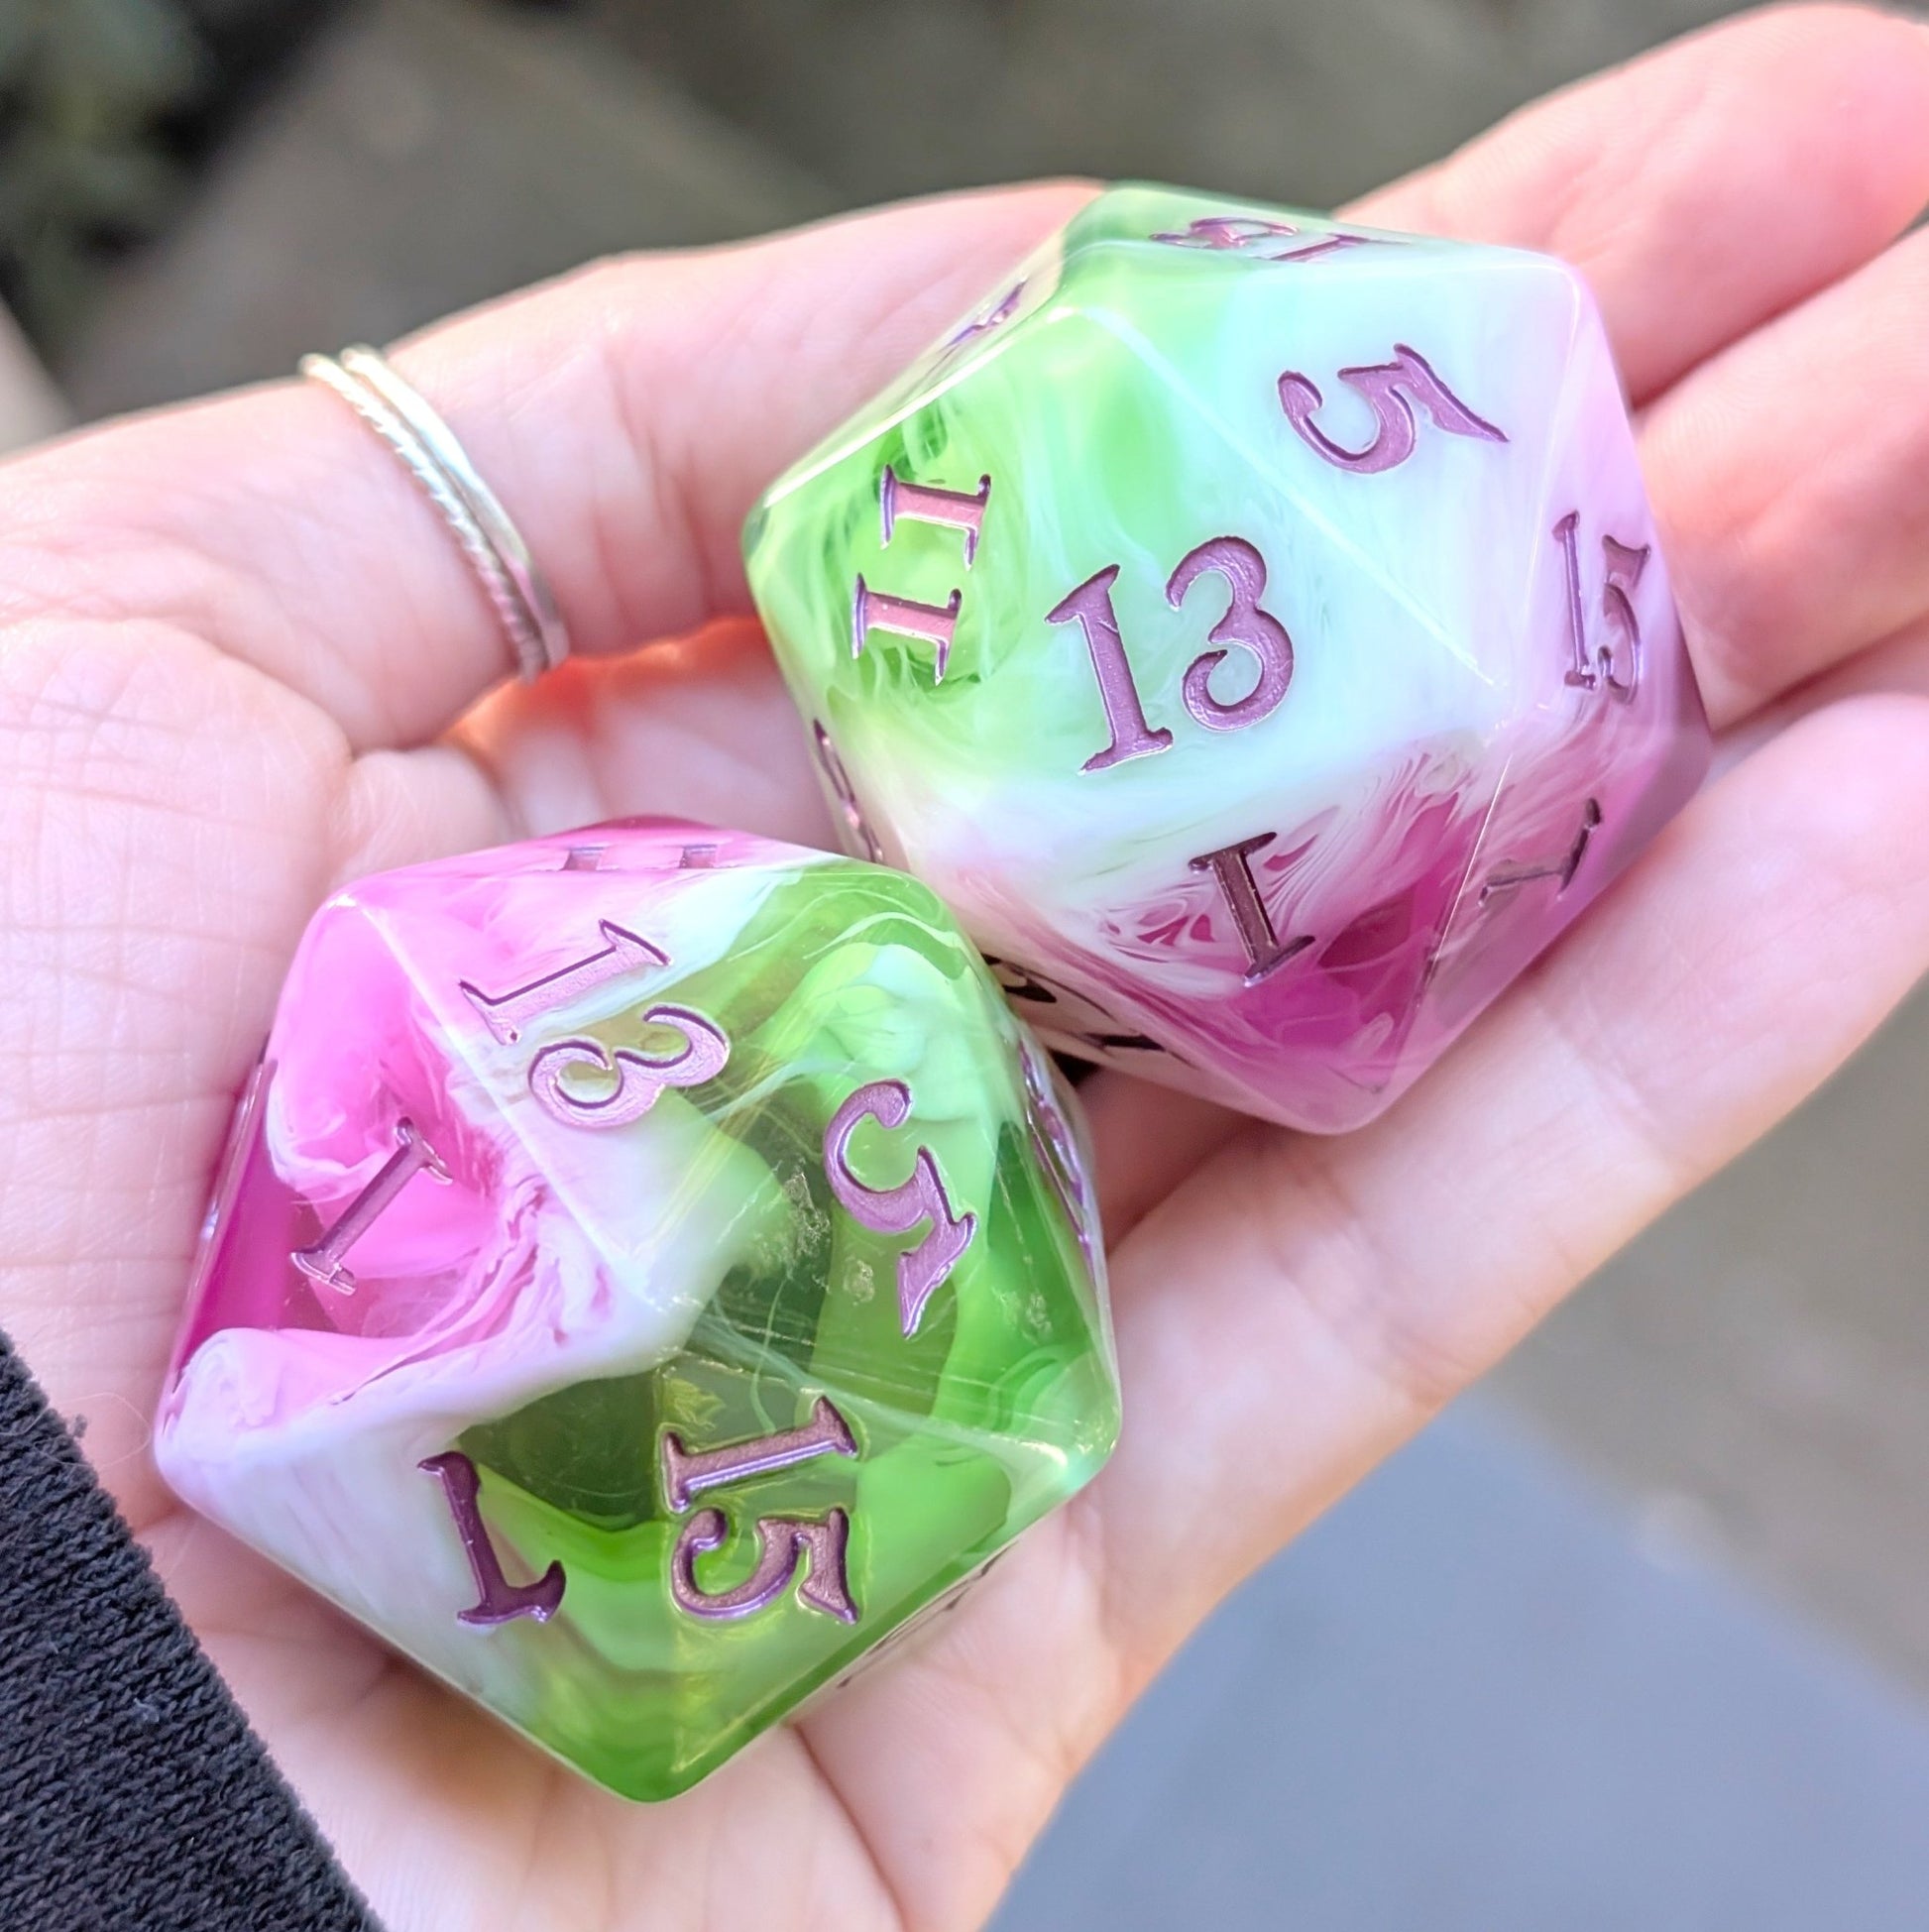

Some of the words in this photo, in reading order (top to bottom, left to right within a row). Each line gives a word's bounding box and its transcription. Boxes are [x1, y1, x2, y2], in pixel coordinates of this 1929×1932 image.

[1277, 343, 1511, 475] 5
[851, 464, 992, 686] 11
[1045, 535, 1295, 775] 13
[1551, 510, 1652, 705] 15
[1189, 831, 1315, 987] 1
[458, 918, 732, 1130] 13
[290, 1116, 454, 1297] 1
[823, 1079, 978, 1340] 5
[660, 1395, 859, 1626] 15
